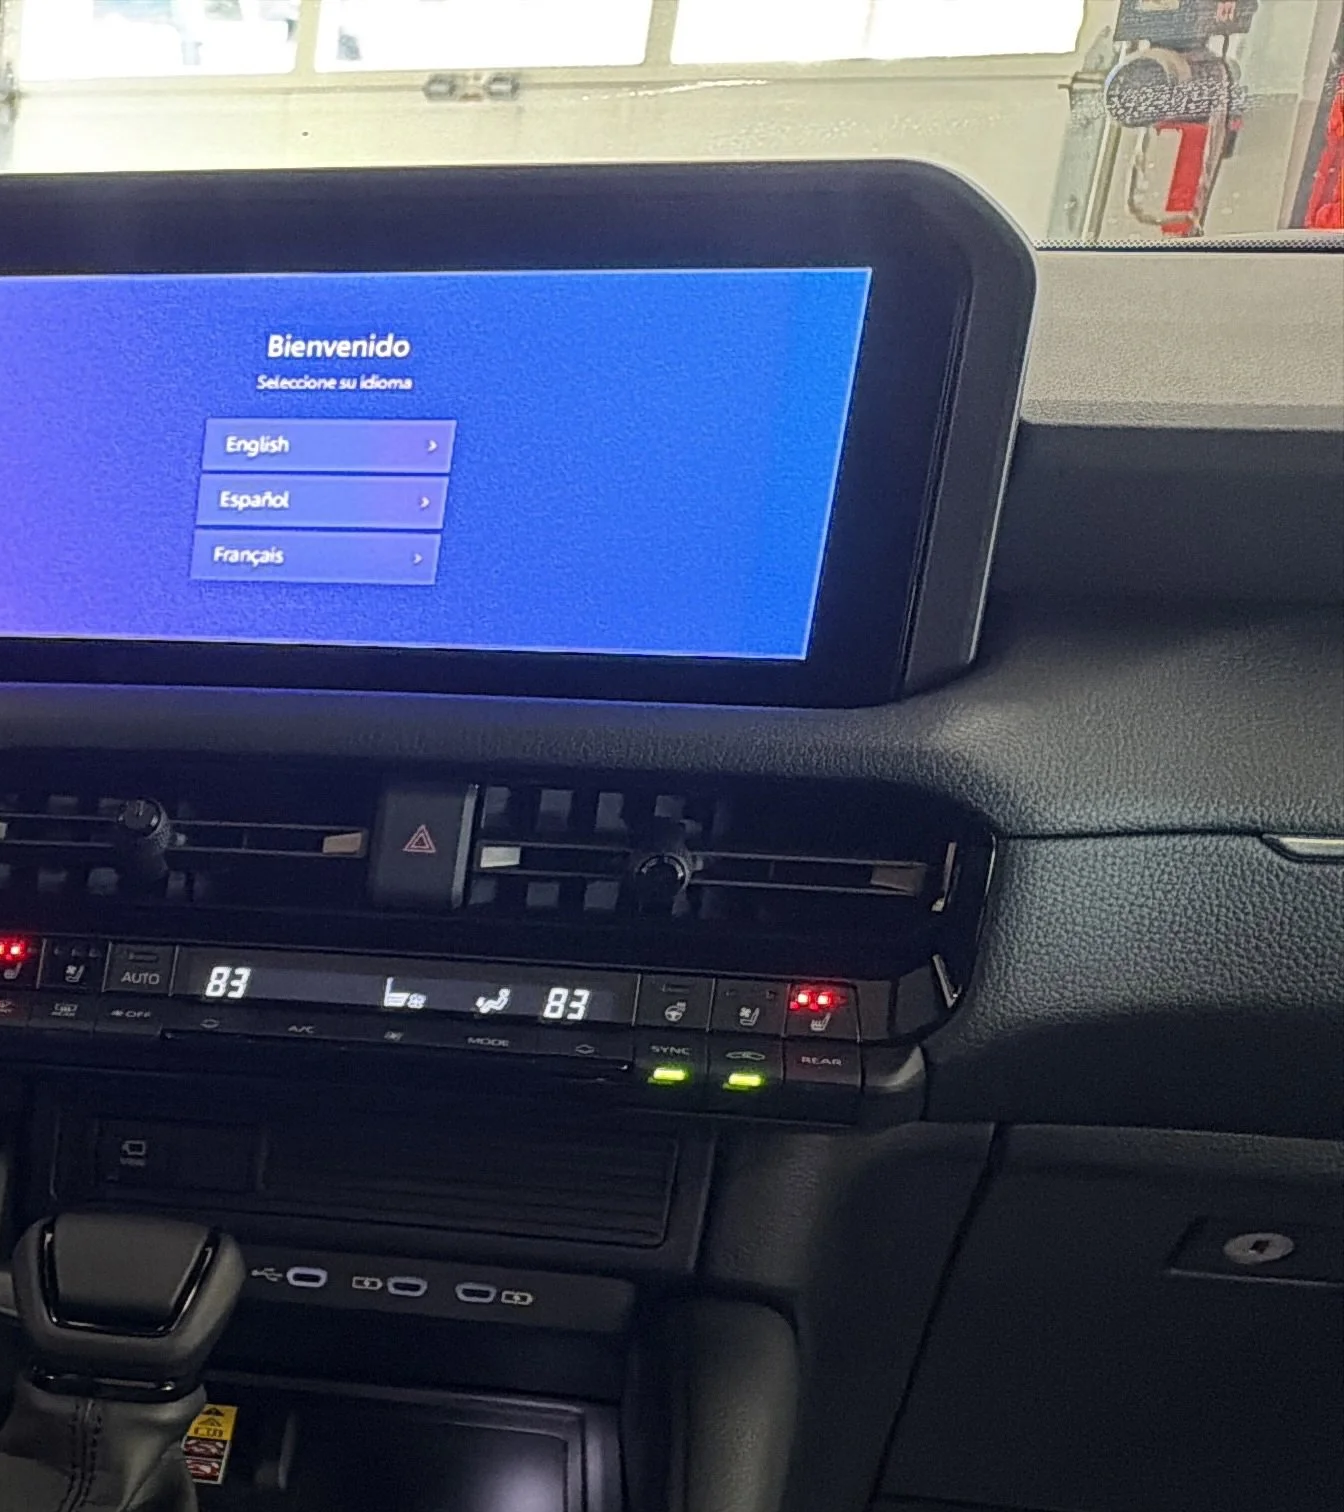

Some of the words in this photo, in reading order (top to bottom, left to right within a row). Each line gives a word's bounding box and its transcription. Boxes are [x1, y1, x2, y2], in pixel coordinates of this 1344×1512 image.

[267, 333, 411, 359] Bienvenido
[256, 375, 338, 390] Seleccione
[339, 377, 357, 390] su
[359, 375, 413, 390] idioma
[225, 435, 290, 458] English
[219, 490, 291, 511] Español
[213, 546, 284, 567] Français
[120, 971, 161, 987] AUTO
[206, 966, 252, 999] 83
[543, 986, 591, 1020] 83
[124, 1009, 151, 1019] OFF
[288, 1024, 315, 1035] A/C
[467, 1036, 510, 1047] MODE
[650, 1045, 691, 1056] SYNC
[800, 1055, 843, 1066] REAR
